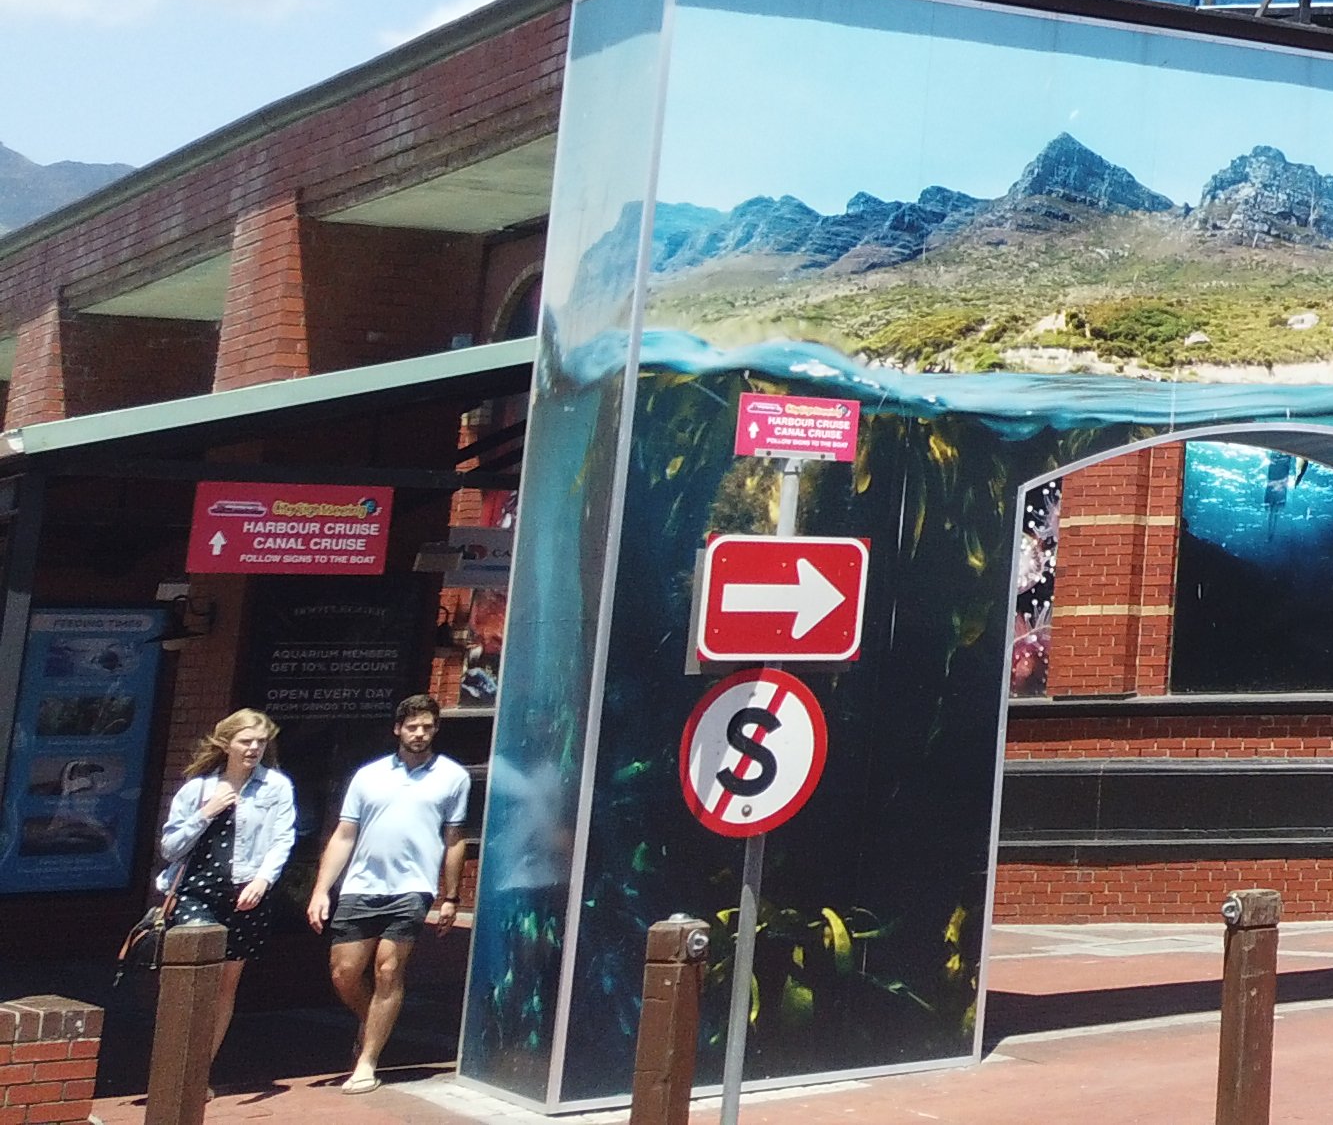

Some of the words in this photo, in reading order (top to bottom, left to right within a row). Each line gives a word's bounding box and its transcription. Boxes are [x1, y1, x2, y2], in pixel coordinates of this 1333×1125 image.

[767, 416, 815, 427] HARBOUR
[816, 418, 851, 430] CRUISE
[774, 427, 806, 437] CANAL
[808, 428, 843, 439] CRUISE
[766, 437, 791, 445] FOLLOW
[811, 439, 820, 447] TO
[820, 440, 832, 448] THE
[832, 441, 849, 449] BOAT
[243, 521, 320, 535] HARBOUR
[323, 523, 380, 536] CRUISE
[253, 537, 306, 550] CANAL
[309, 538, 367, 551] CRUISE
[239, 554, 281, 563] FOLLOW
[282, 554, 313, 564] SIGNS
[314, 555, 328, 564] TO
[329, 555, 349, 564] THE
[351, 556, 377, 564] BOAT
[272, 650, 339, 659] AQUARIUM
[342, 649, 399, 658] MEMBERS
[270, 662, 298, 672] GET
[330, 662, 397, 672] DISCOUNT
[267, 689, 309, 700] OPEN
[313, 688, 360, 700] EVERY
[365, 688, 393, 699] DAY
[266, 703, 298, 711] FROM
[342, 702, 357, 711] TO
[715, 707, 782, 797] S
